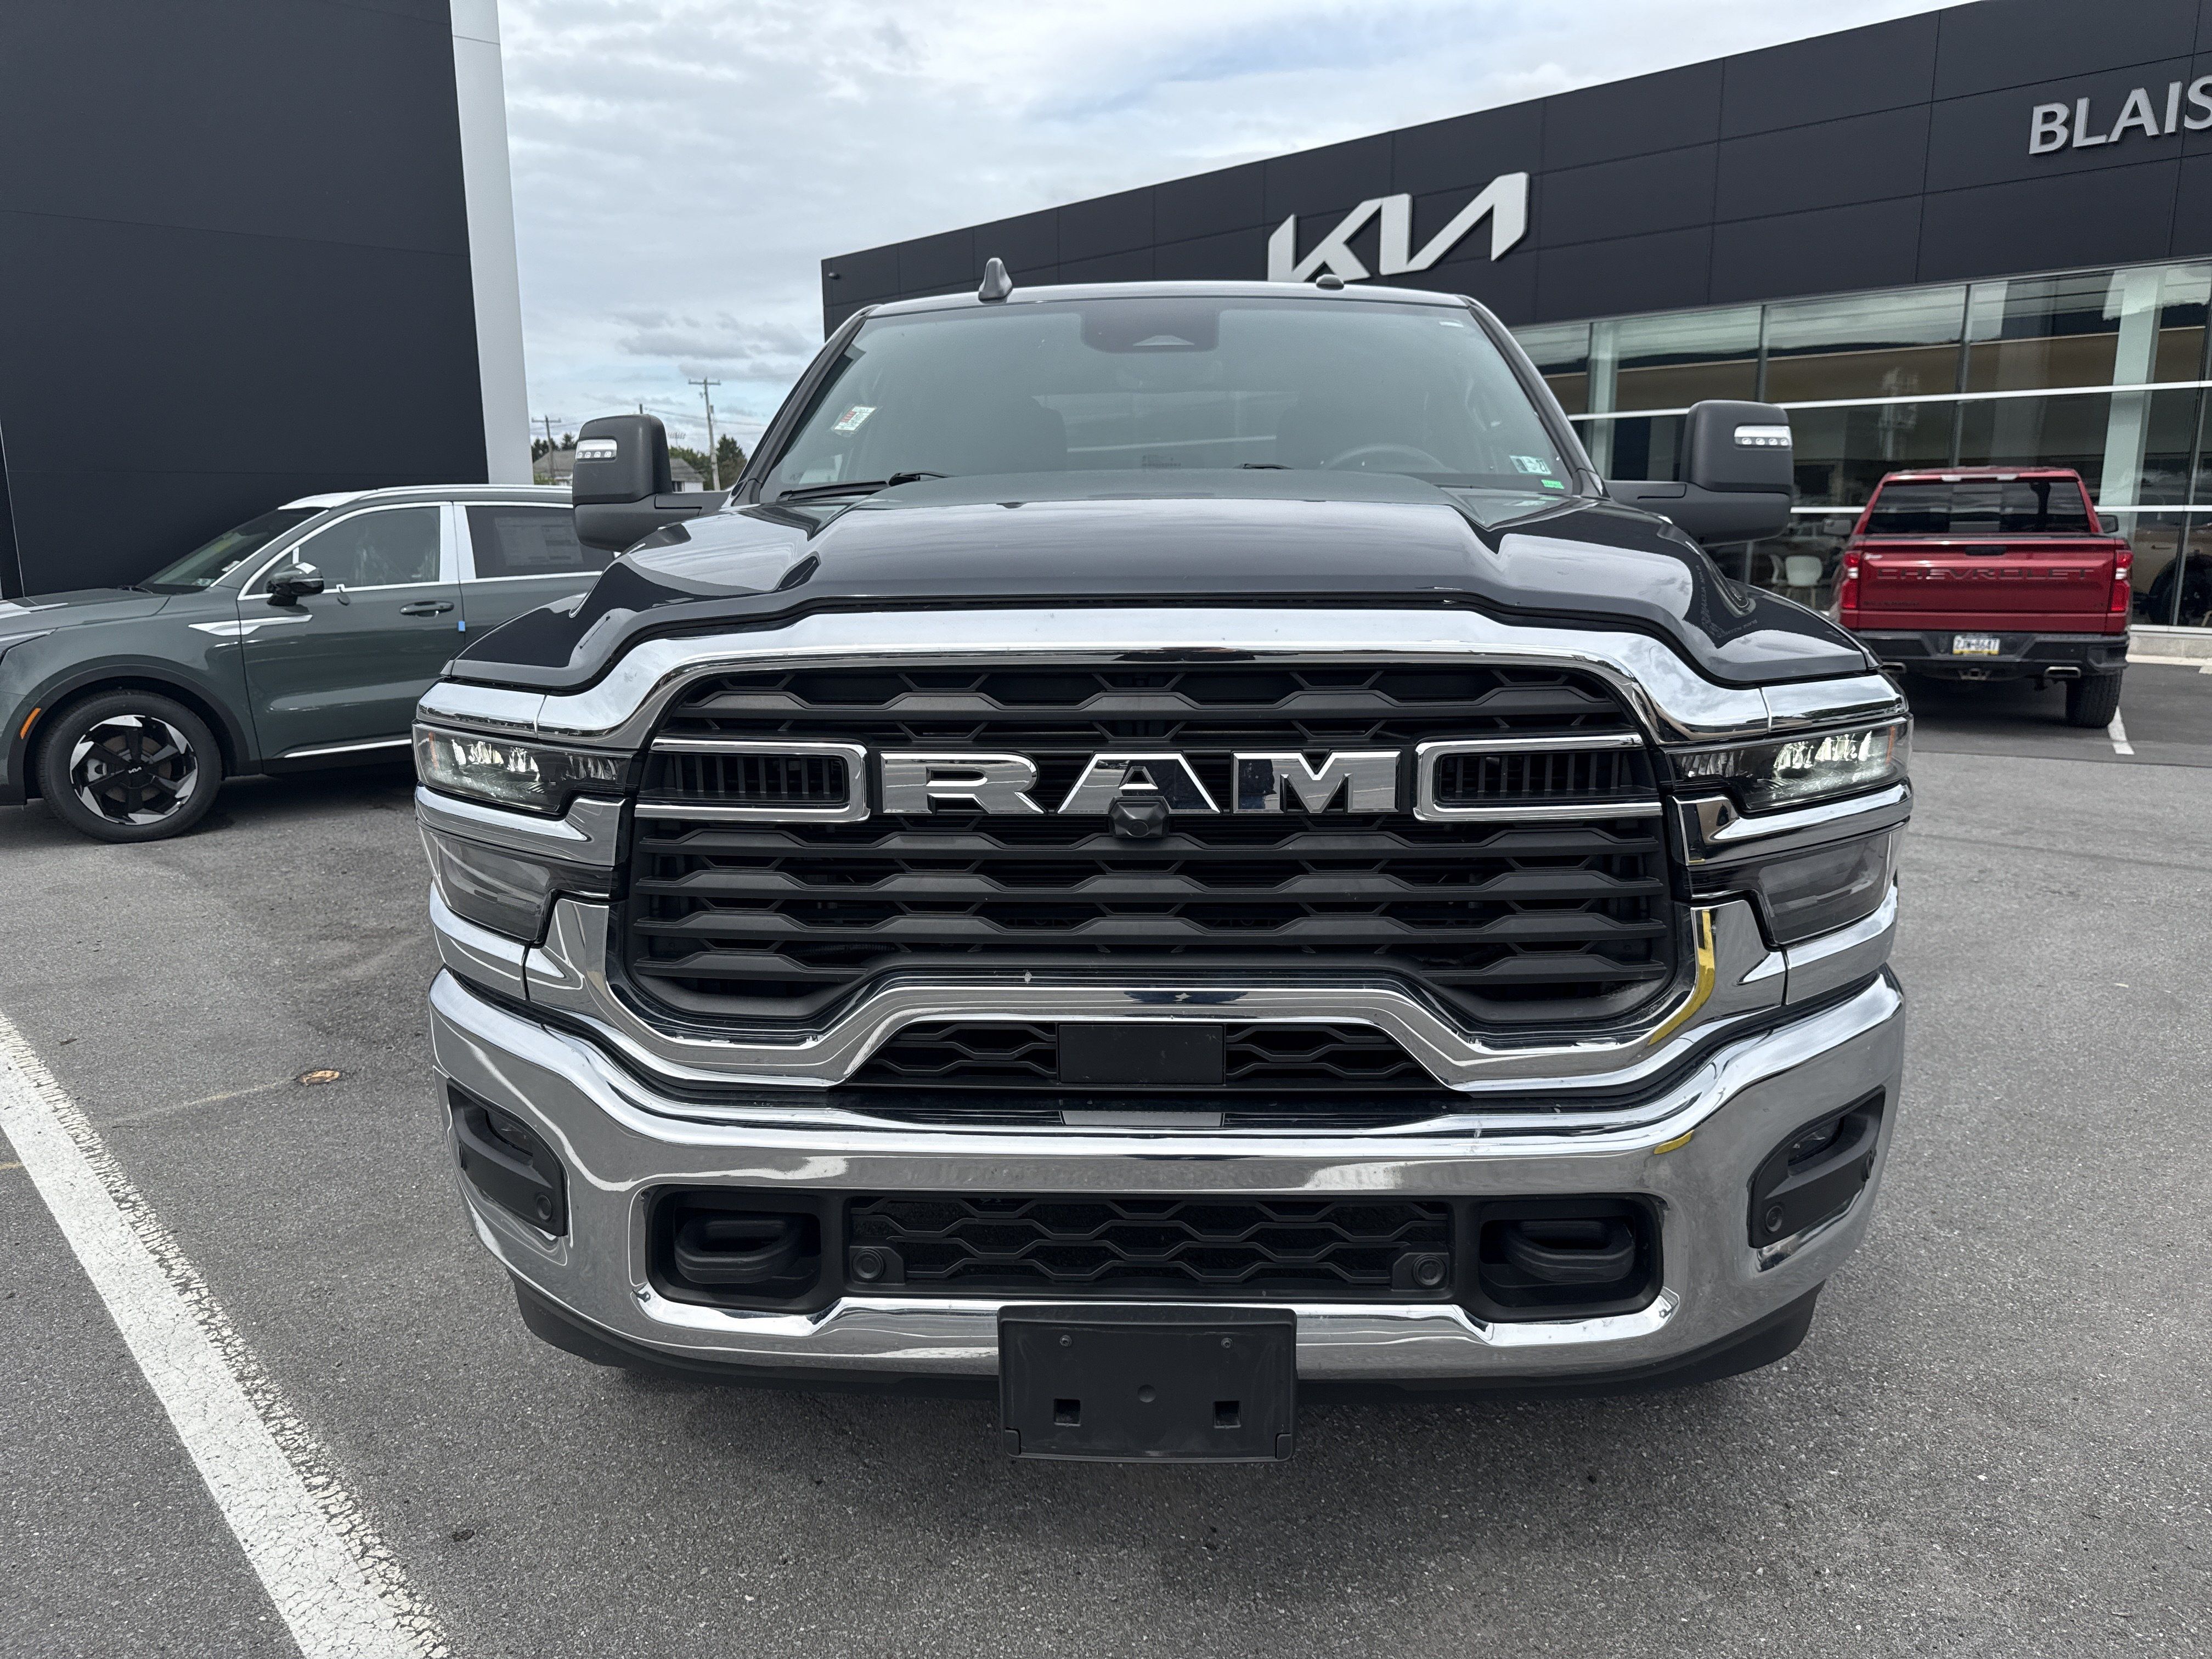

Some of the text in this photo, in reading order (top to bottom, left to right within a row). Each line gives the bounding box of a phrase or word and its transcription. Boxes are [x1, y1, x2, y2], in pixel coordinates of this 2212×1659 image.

[2029, 75, 2212, 154] BLAIS
[1268, 172, 1530, 283] KIA
[1877, 568, 2094, 580] CHEVROLET
[880, 751, 1401, 815] RAM
